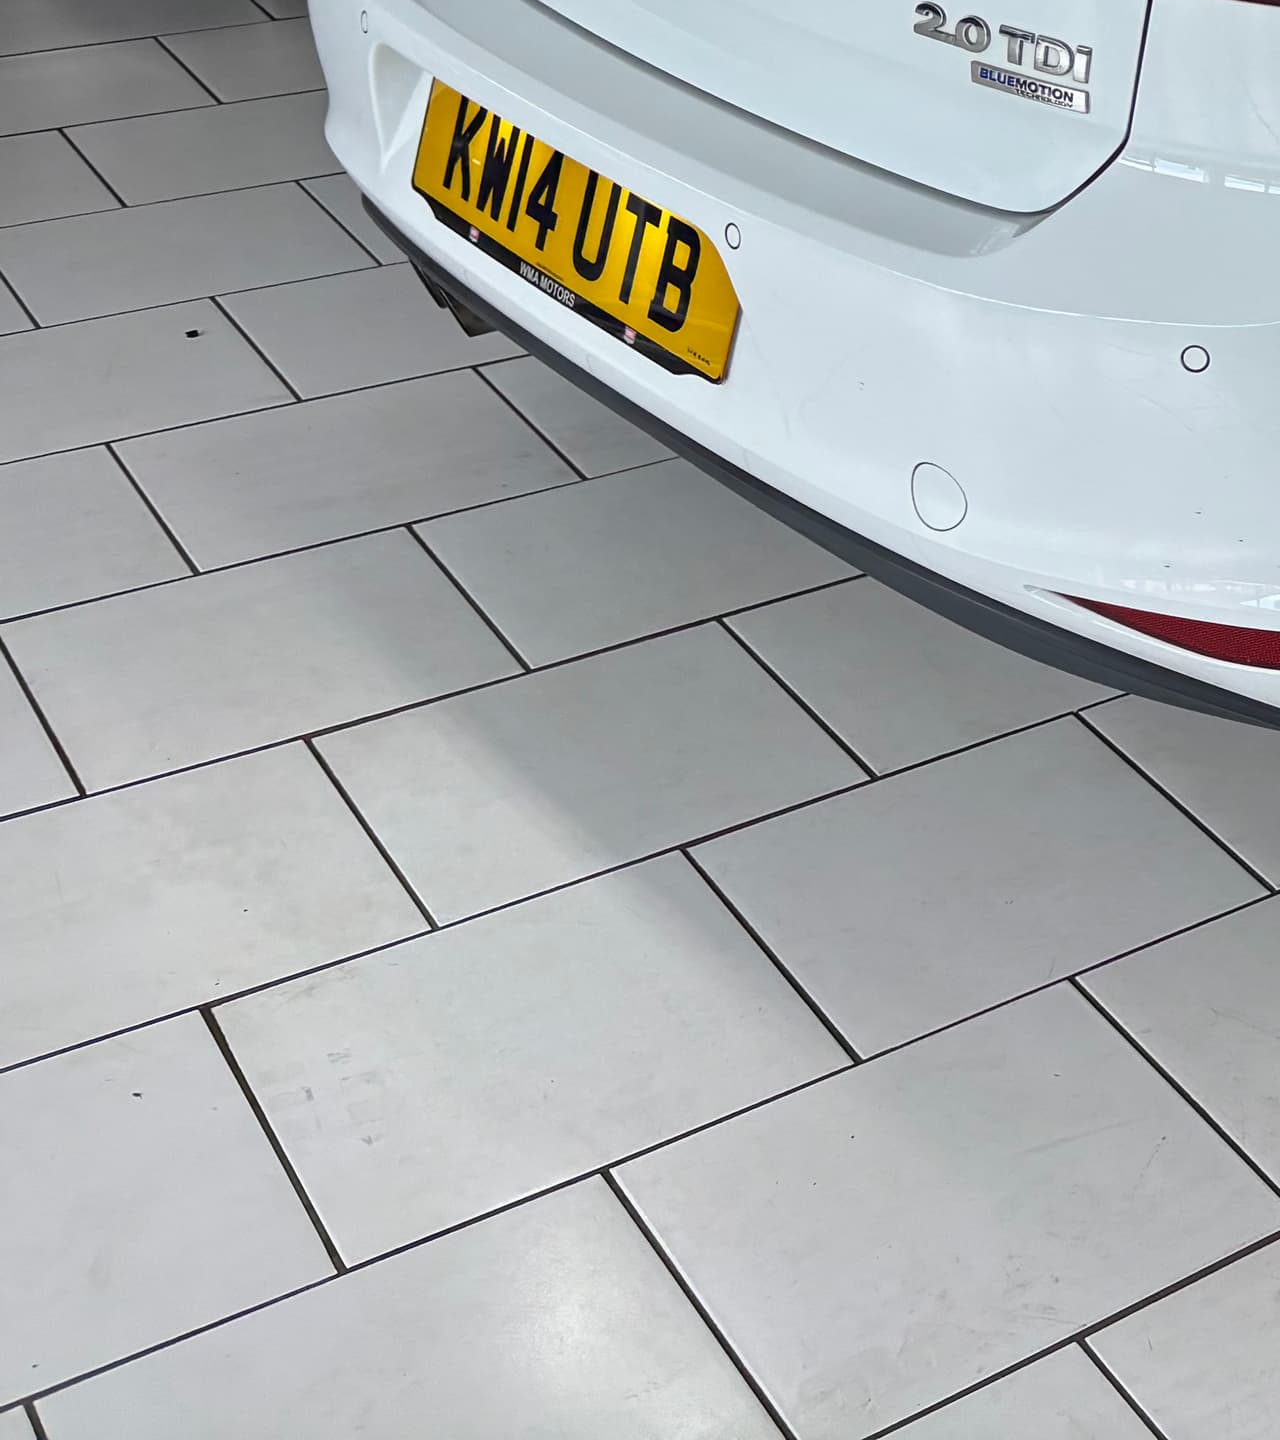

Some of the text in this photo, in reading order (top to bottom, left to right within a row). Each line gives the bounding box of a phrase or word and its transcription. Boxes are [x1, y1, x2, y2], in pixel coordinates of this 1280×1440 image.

[913, 0, 991, 54] 2.0
[979, 66, 1074, 103] BLUEMOTION
[442, 95, 701, 333] KW14 UTB
[519, 261, 540, 283] WMA
[540, 275, 576, 308] MOTORS
